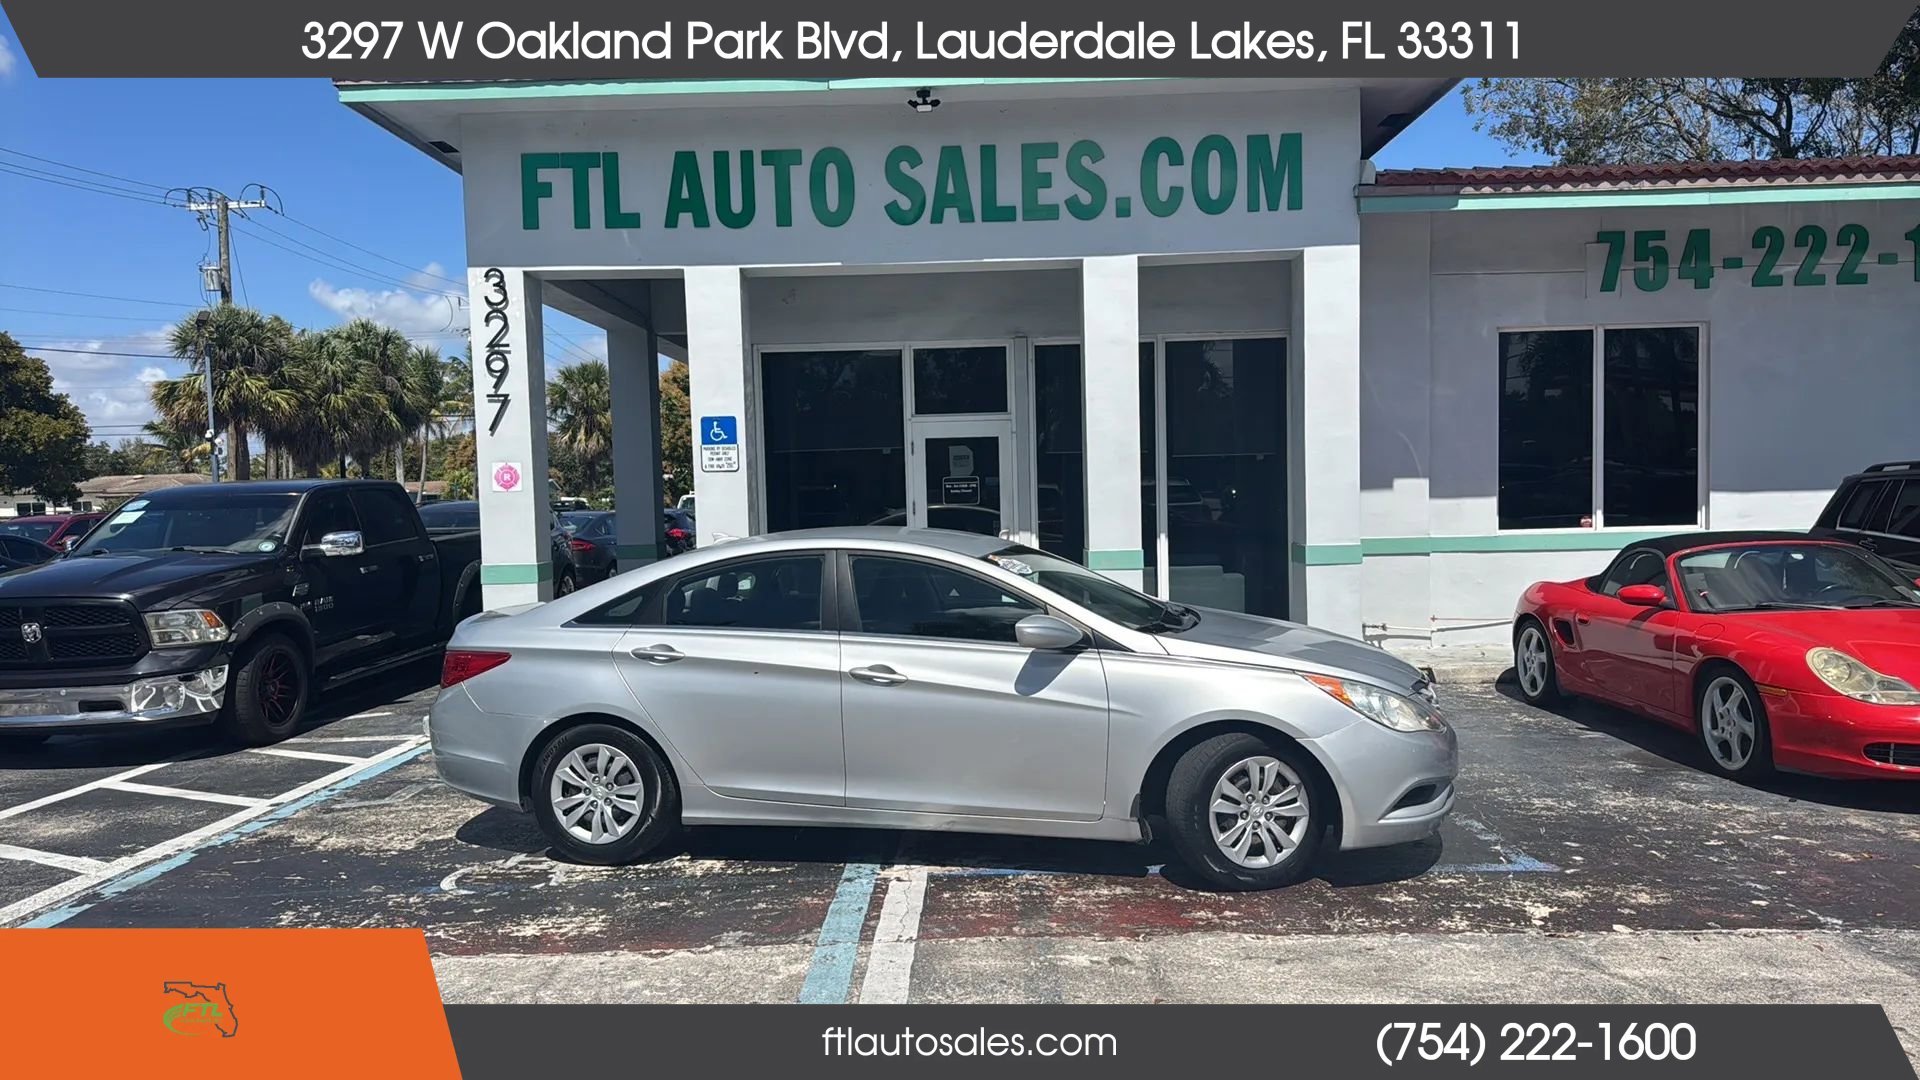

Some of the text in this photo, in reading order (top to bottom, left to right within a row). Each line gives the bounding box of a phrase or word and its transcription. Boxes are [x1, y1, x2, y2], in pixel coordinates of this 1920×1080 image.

[522, 133, 1303, 230] FTL AUTO SALES.COM
[484, 267, 511, 435] 3297
[503, 473, 512, 481] R
